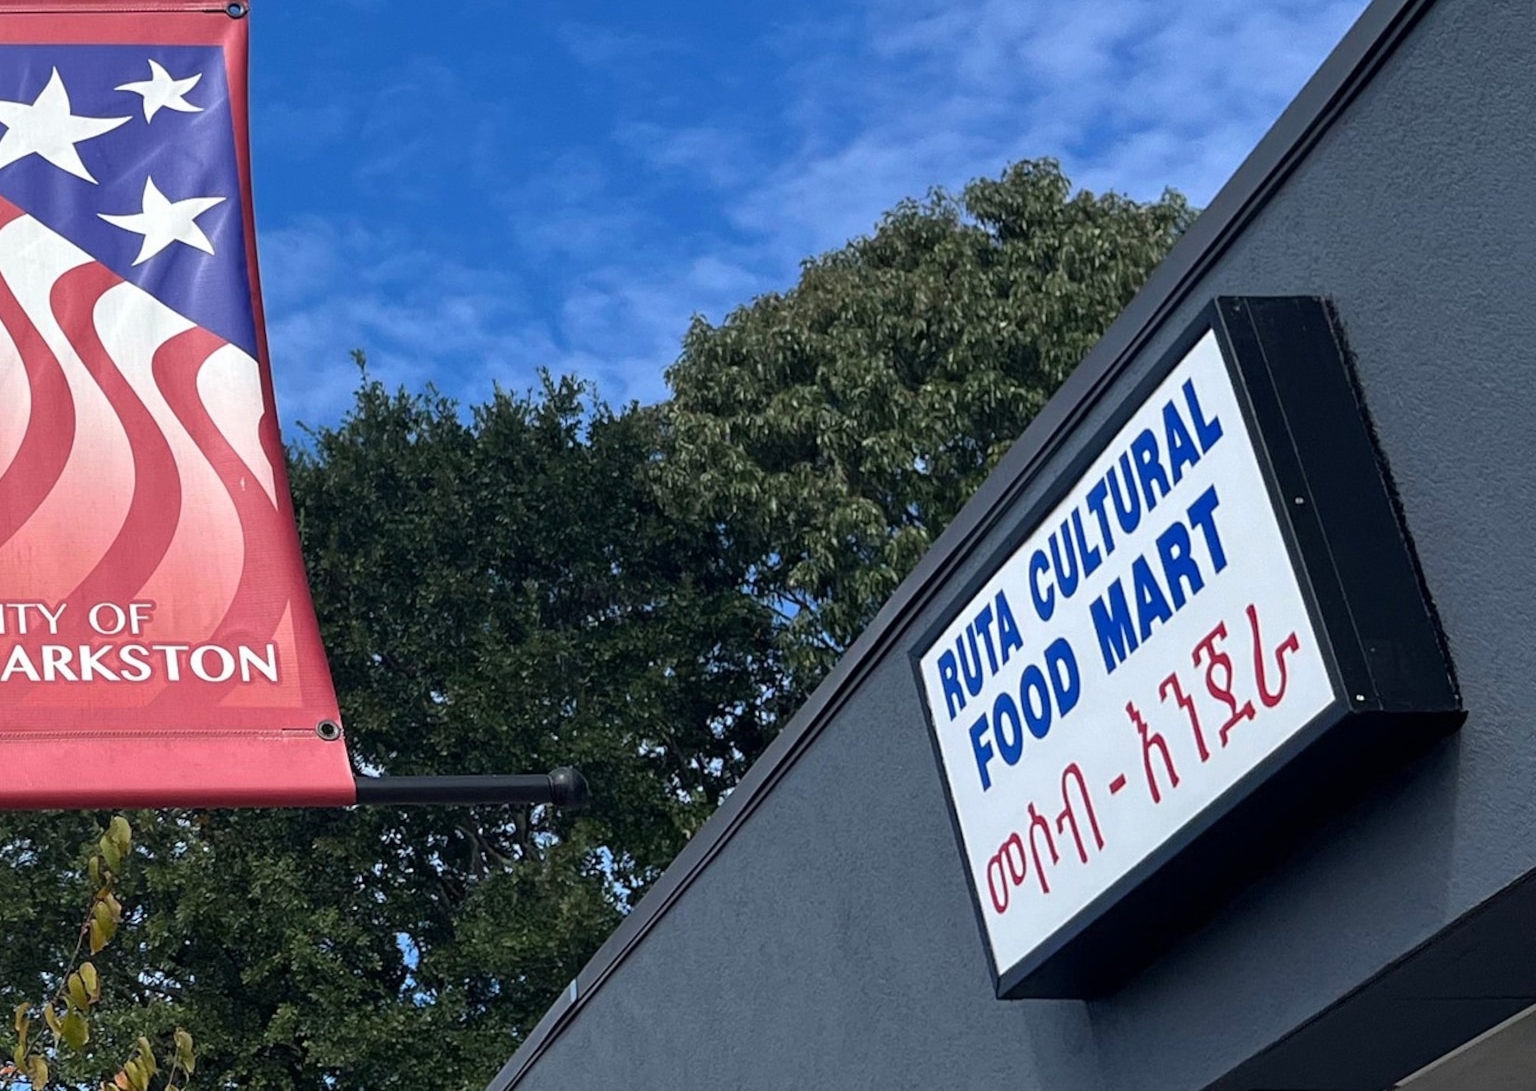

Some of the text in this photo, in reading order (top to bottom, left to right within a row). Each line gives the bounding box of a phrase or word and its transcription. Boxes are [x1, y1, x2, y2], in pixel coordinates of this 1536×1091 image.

[88, 602, 153, 636] OF
[936, 377, 1224, 722] RUTA CULTURAL
[968, 483, 1228, 793] FOOD MART
